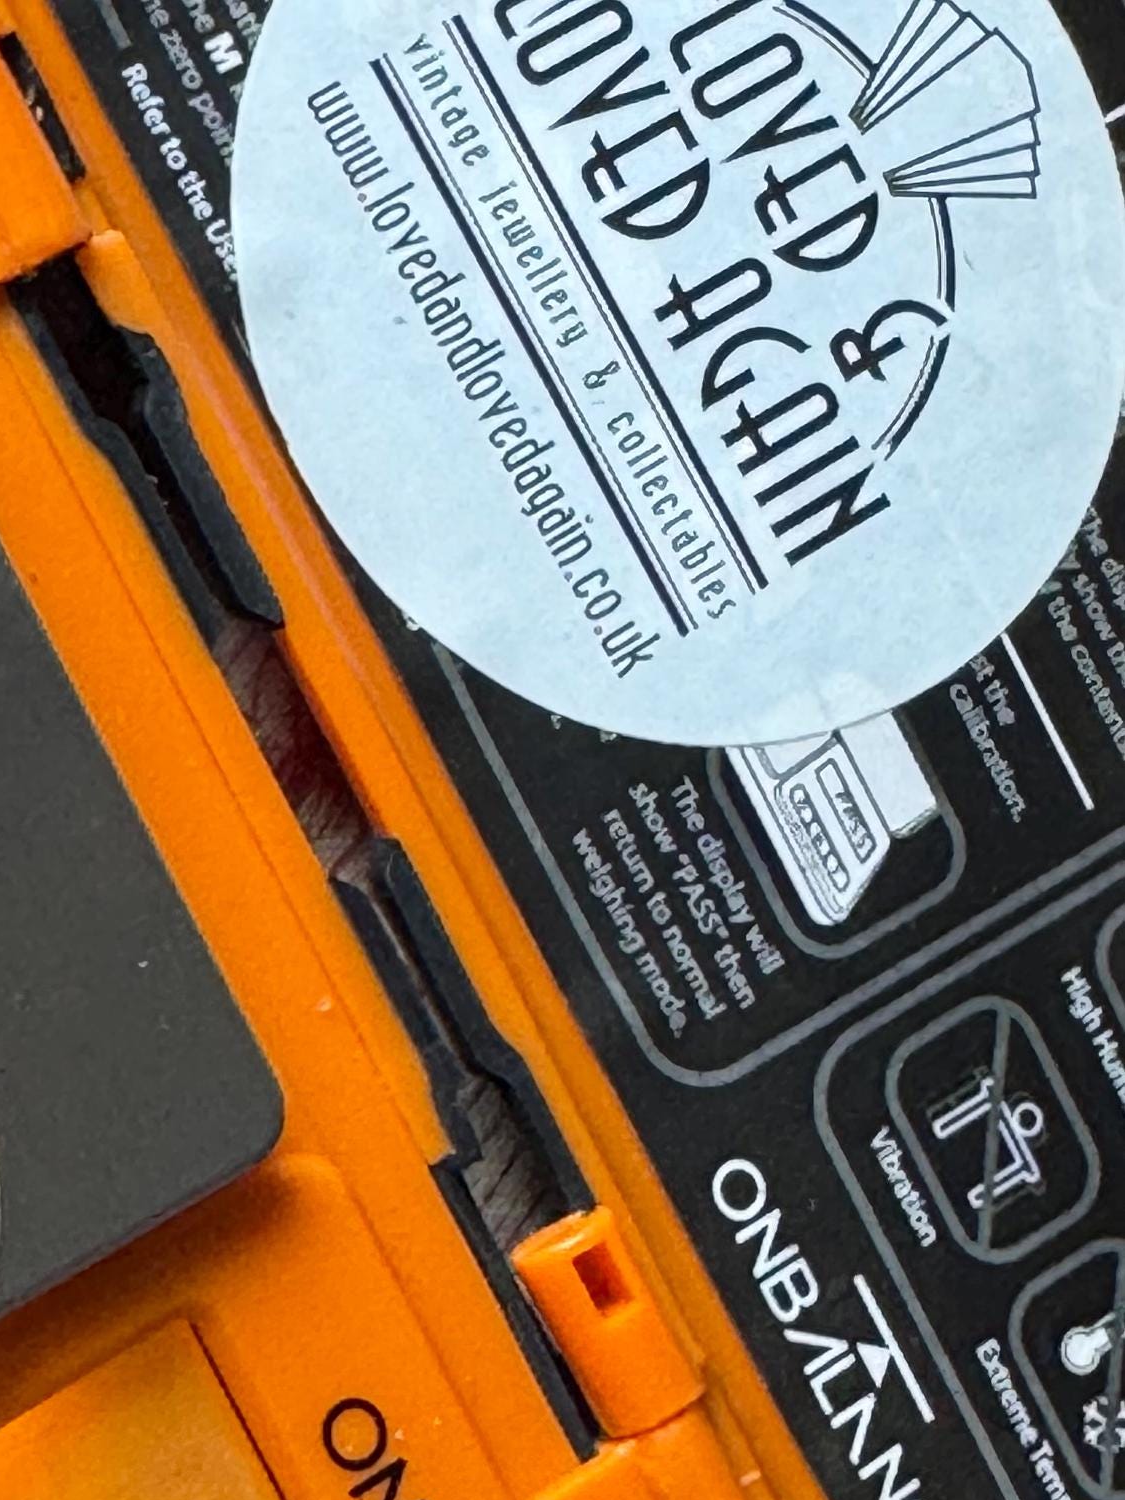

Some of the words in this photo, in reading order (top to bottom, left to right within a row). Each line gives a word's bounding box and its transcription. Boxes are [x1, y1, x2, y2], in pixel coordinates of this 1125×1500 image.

[158, 28, 204, 90] zero
[204, 30, 244, 74] M
[121, 62, 172, 135] Refer
[159, 136, 188, 171] to
[177, 170, 214, 221] the
[669, 0, 880, 273] LOVED
[828, 298, 948, 383] &
[306, 80, 661, 679] www.lovedandlovedagain.co.uk
[403, 32, 491, 167] vintage
[477, 180, 589, 349] jewellery
[581, 360, 622, 390] &
[606, 411, 737, 620] collectables
[653, 257, 891, 567] AGAIN
[1047, 595, 1078, 642] the
[1072, 572, 1117, 641] show
[949, 683, 1027, 824] calibration.
[983, 678, 1016, 727] the
[572, 827, 646, 955] weighing
[635, 951, 688, 1038] mode.
[603, 808, 655, 894] return
[646, 891, 673, 926] to
[662, 924, 728, 1020] normal
[627, 782, 678, 854] show
[713, 943, 756, 1010] then
[671, 775, 705, 832] The
[696, 833, 756, 924] display
[745, 923, 786, 975] will
[1060, 965, 1103, 1033] High
[870, 1126, 937, 1248] Vibration
[975, 1337, 1039, 1447] Extreme
